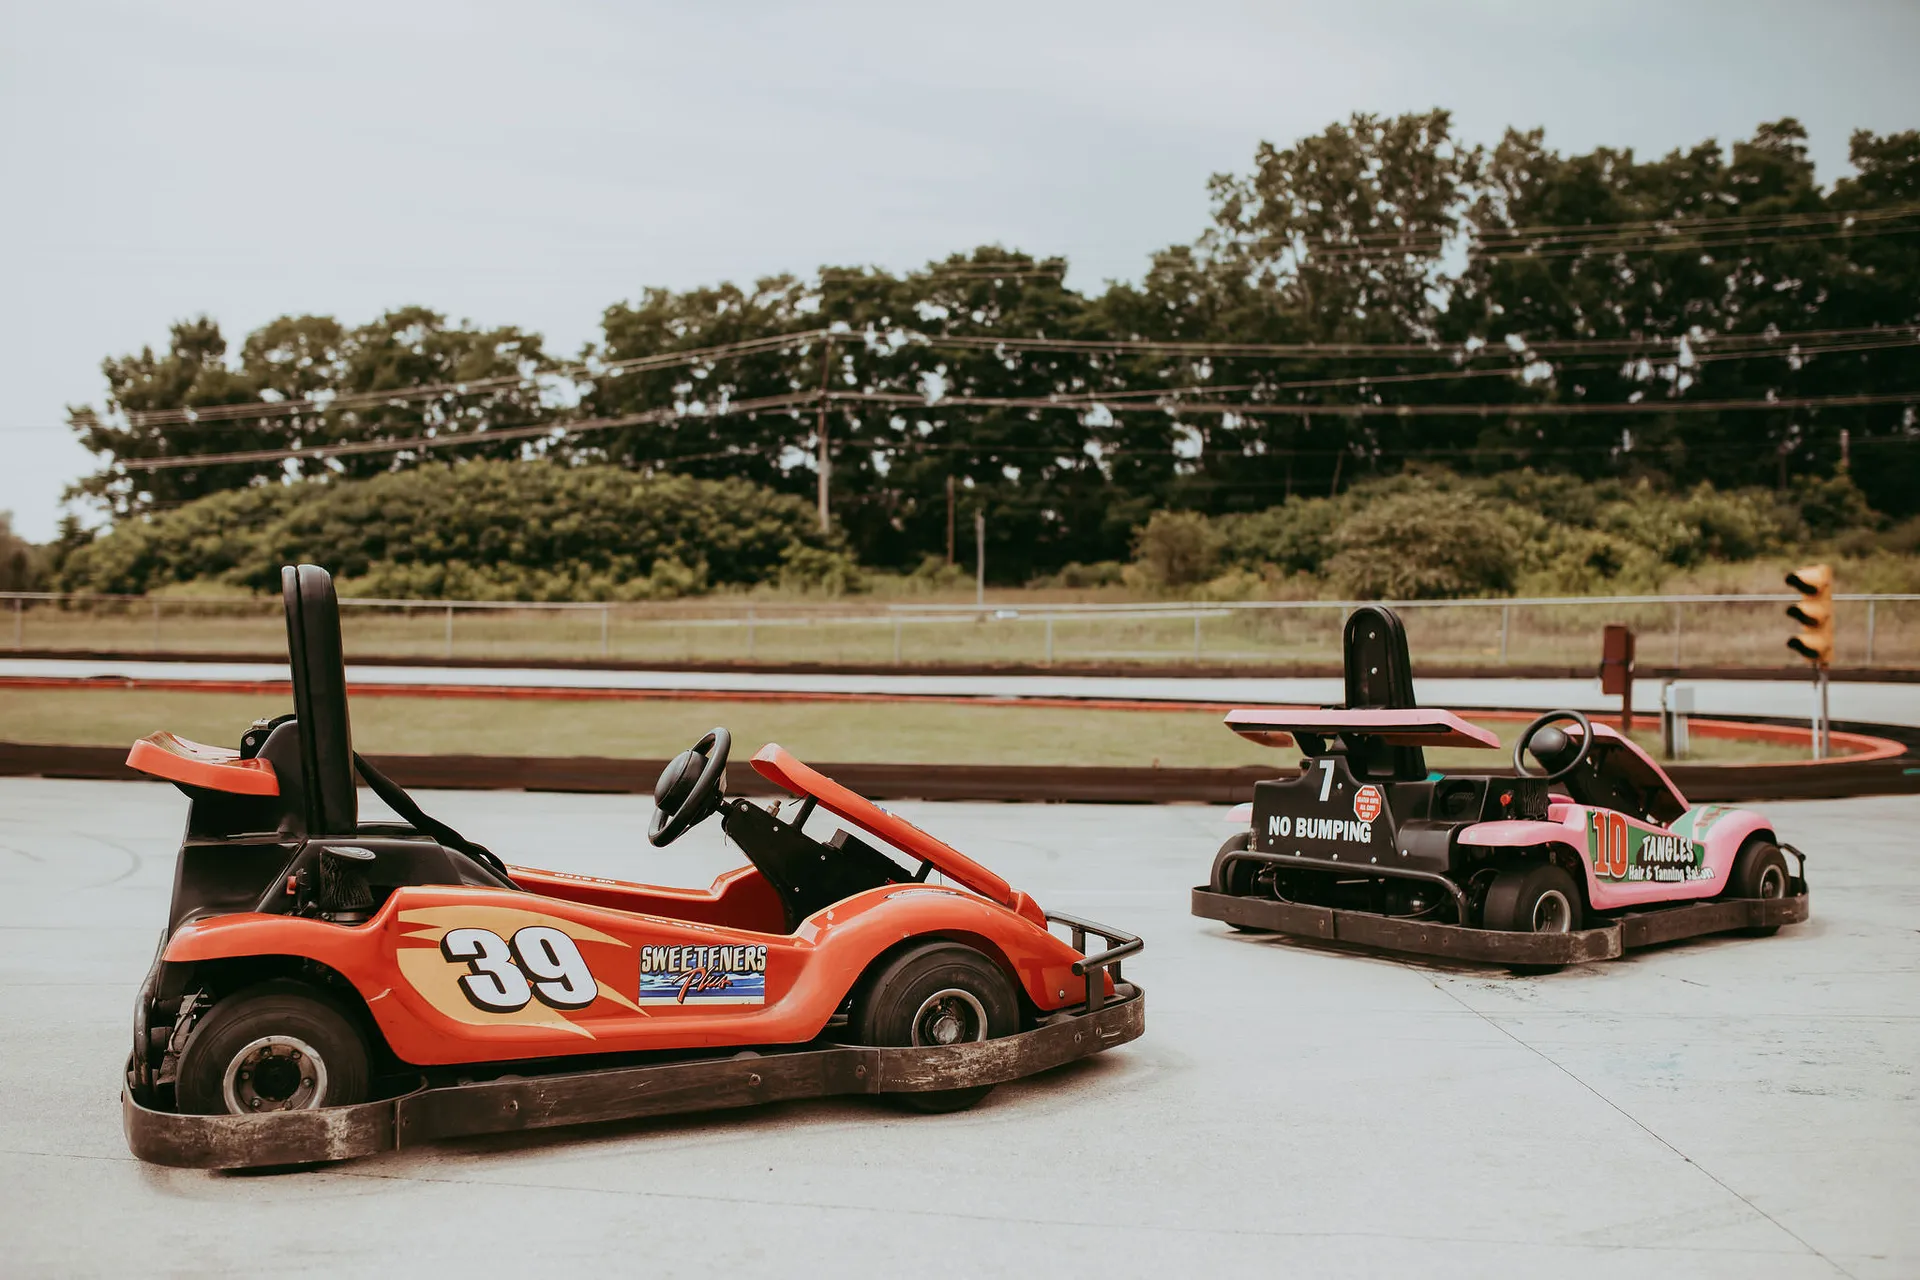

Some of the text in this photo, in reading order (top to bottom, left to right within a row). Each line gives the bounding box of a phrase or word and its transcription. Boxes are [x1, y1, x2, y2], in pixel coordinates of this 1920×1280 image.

[1319, 759, 1335, 802] 7
[1268, 815, 1372, 843] NO BUMPING
[1592, 808, 1629, 880] 10
[1642, 835, 1694, 863] TANGLES
[1628, 864, 1645, 881] Hair
[1653, 864, 1685, 883] Tanning
[439, 925, 599, 1014] 39
[640, 944, 768, 975] SWEETENERS
[671, 965, 734, 1005] Plus
